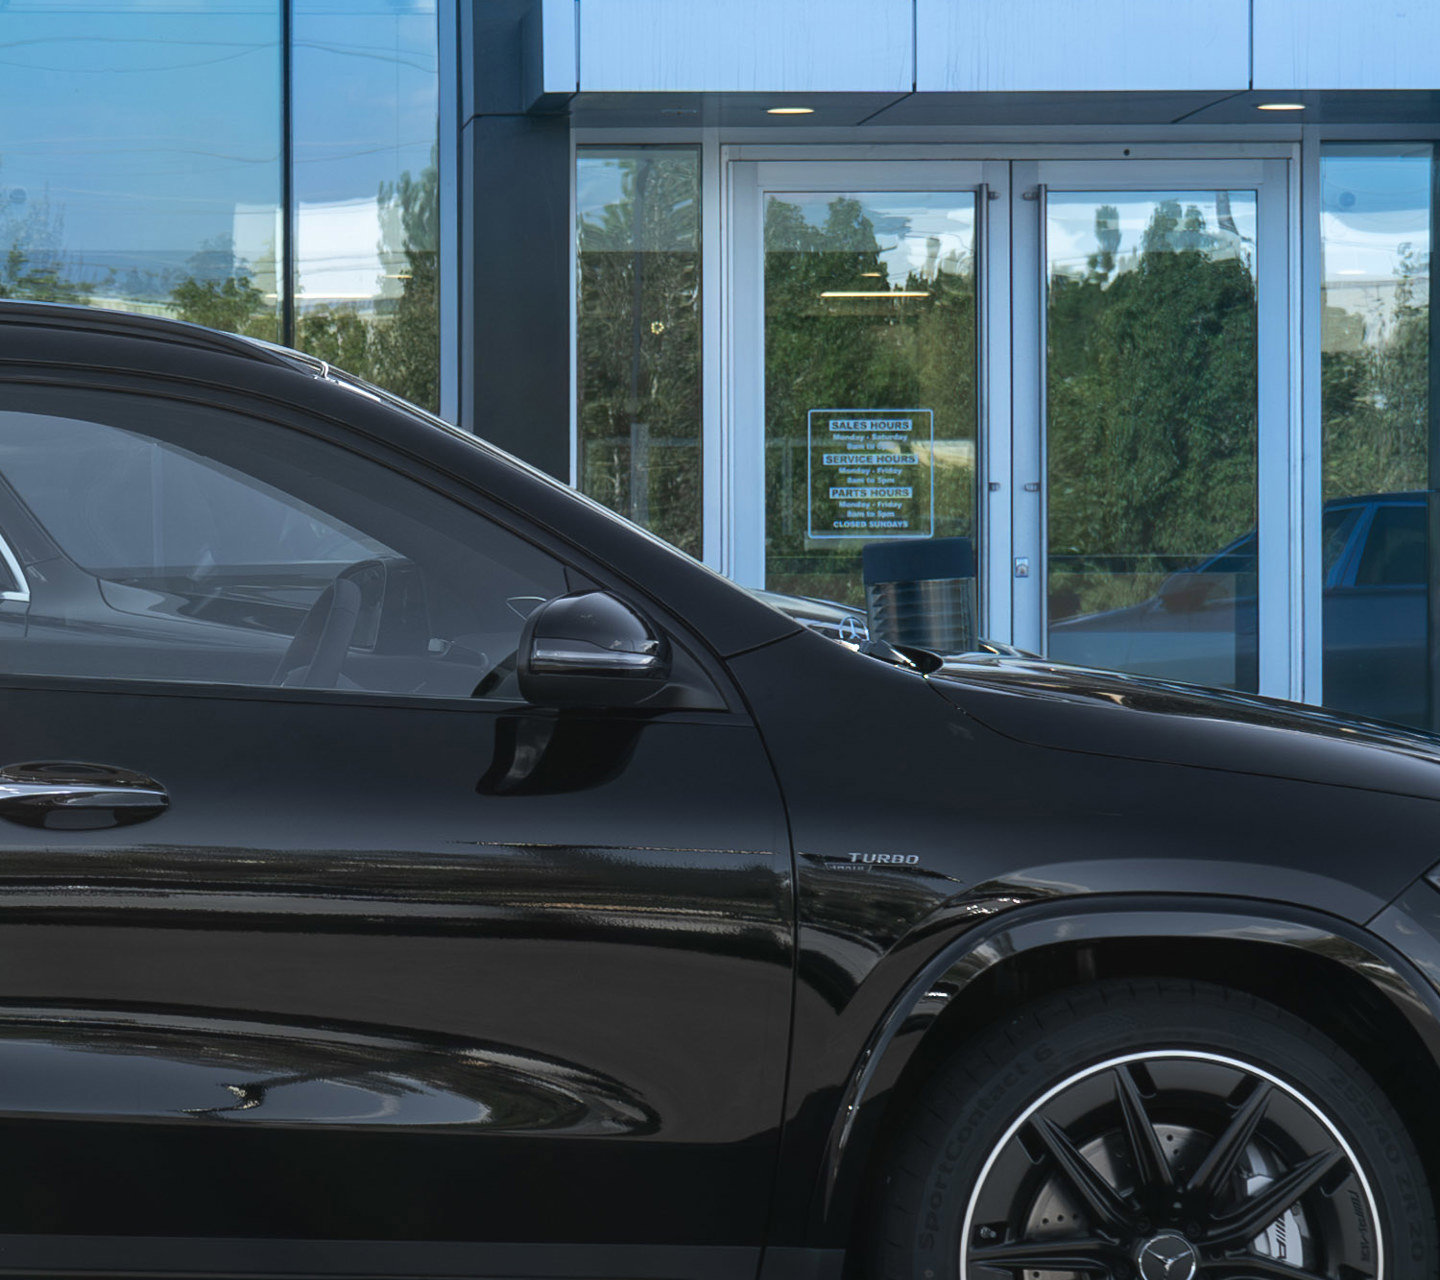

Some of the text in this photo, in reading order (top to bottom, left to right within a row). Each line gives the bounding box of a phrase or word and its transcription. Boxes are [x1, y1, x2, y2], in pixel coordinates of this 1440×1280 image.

[832, 421, 909, 430] SALES HOURS
[825, 455, 915, 464] SERVICE HOURS
[839, 467, 871, 475] Monday
[877, 467, 903, 475] Friday
[832, 488, 909, 497] PARTS HOURS
[839, 501, 870, 509] Monday
[877, 501, 902, 509] Friday
[833, 520, 909, 528] CLOSED SUNDAYS
[848, 852, 919, 864] TURBO
[919, 1042, 1055, 1251] SportContact 6
